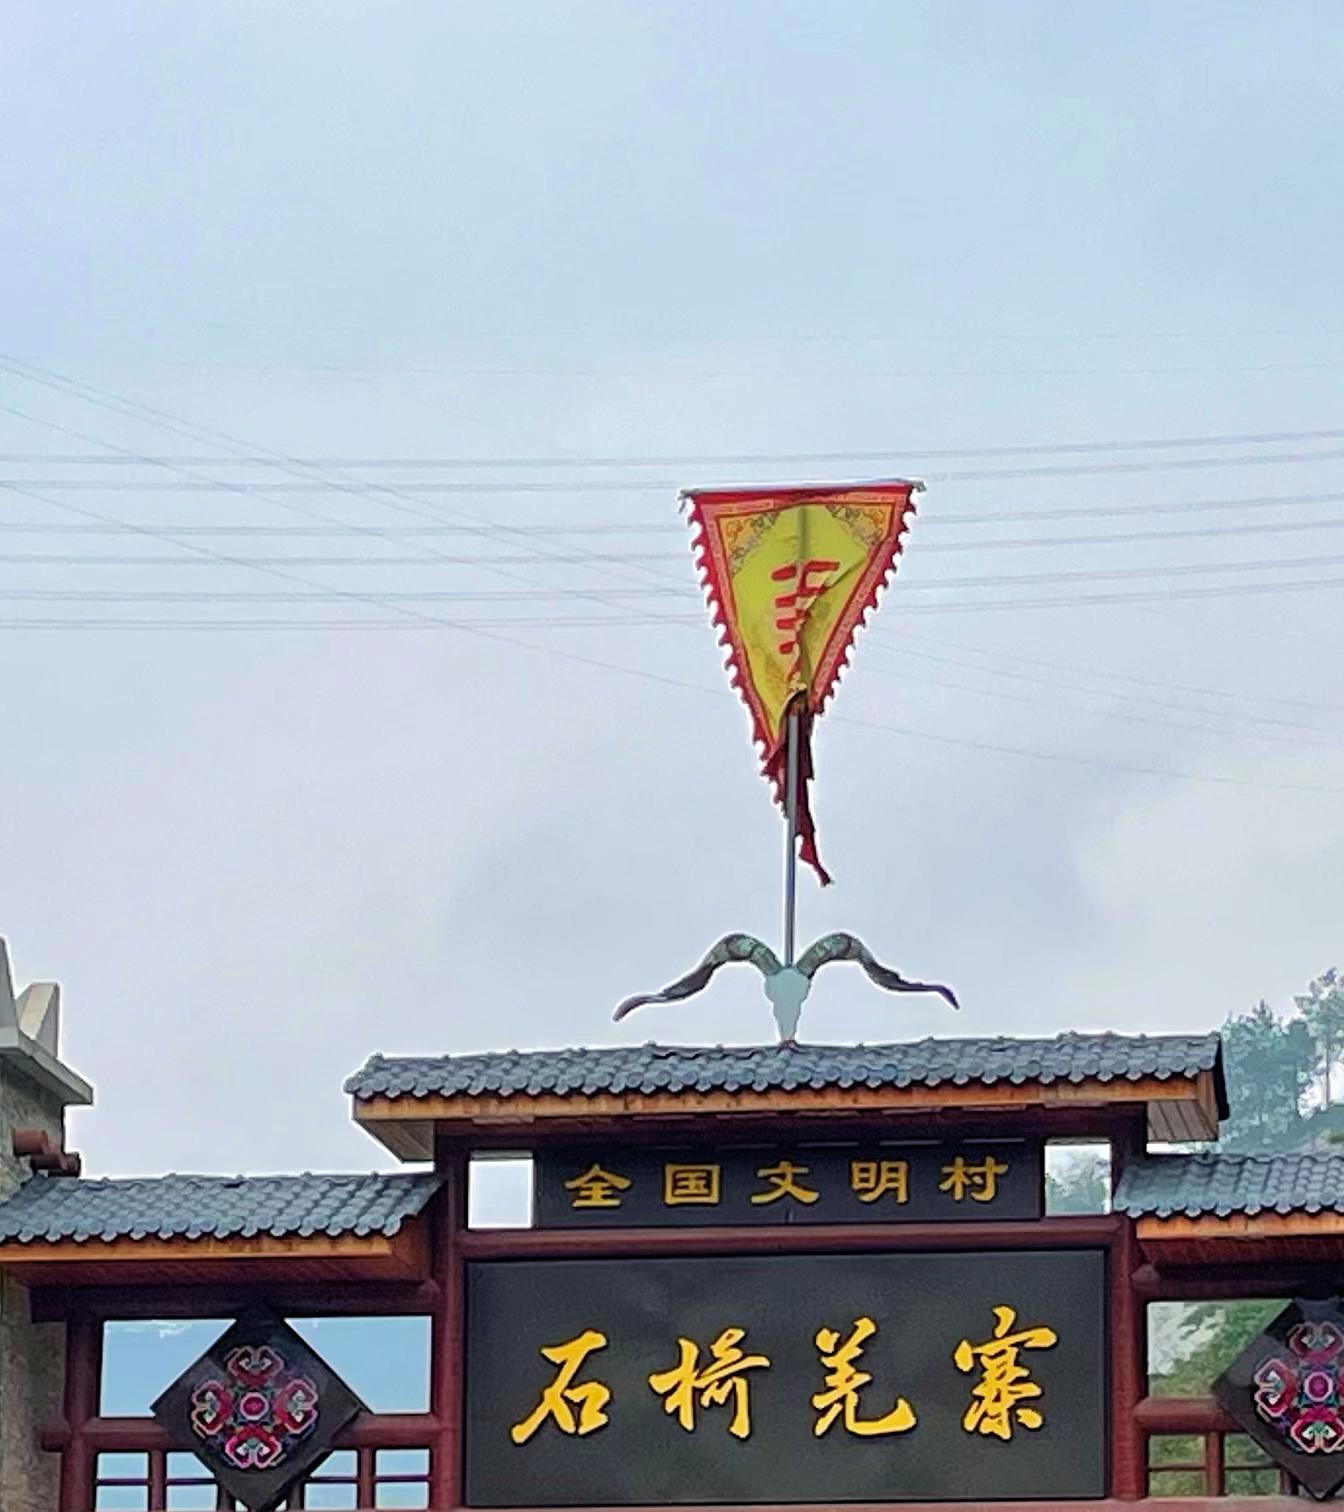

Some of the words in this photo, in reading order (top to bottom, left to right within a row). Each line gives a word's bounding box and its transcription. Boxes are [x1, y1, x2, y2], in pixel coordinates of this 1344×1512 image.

[563, 1155, 1010, 1208] 全国文明村
[509, 1304, 1059, 1445] 石椅羌寨
